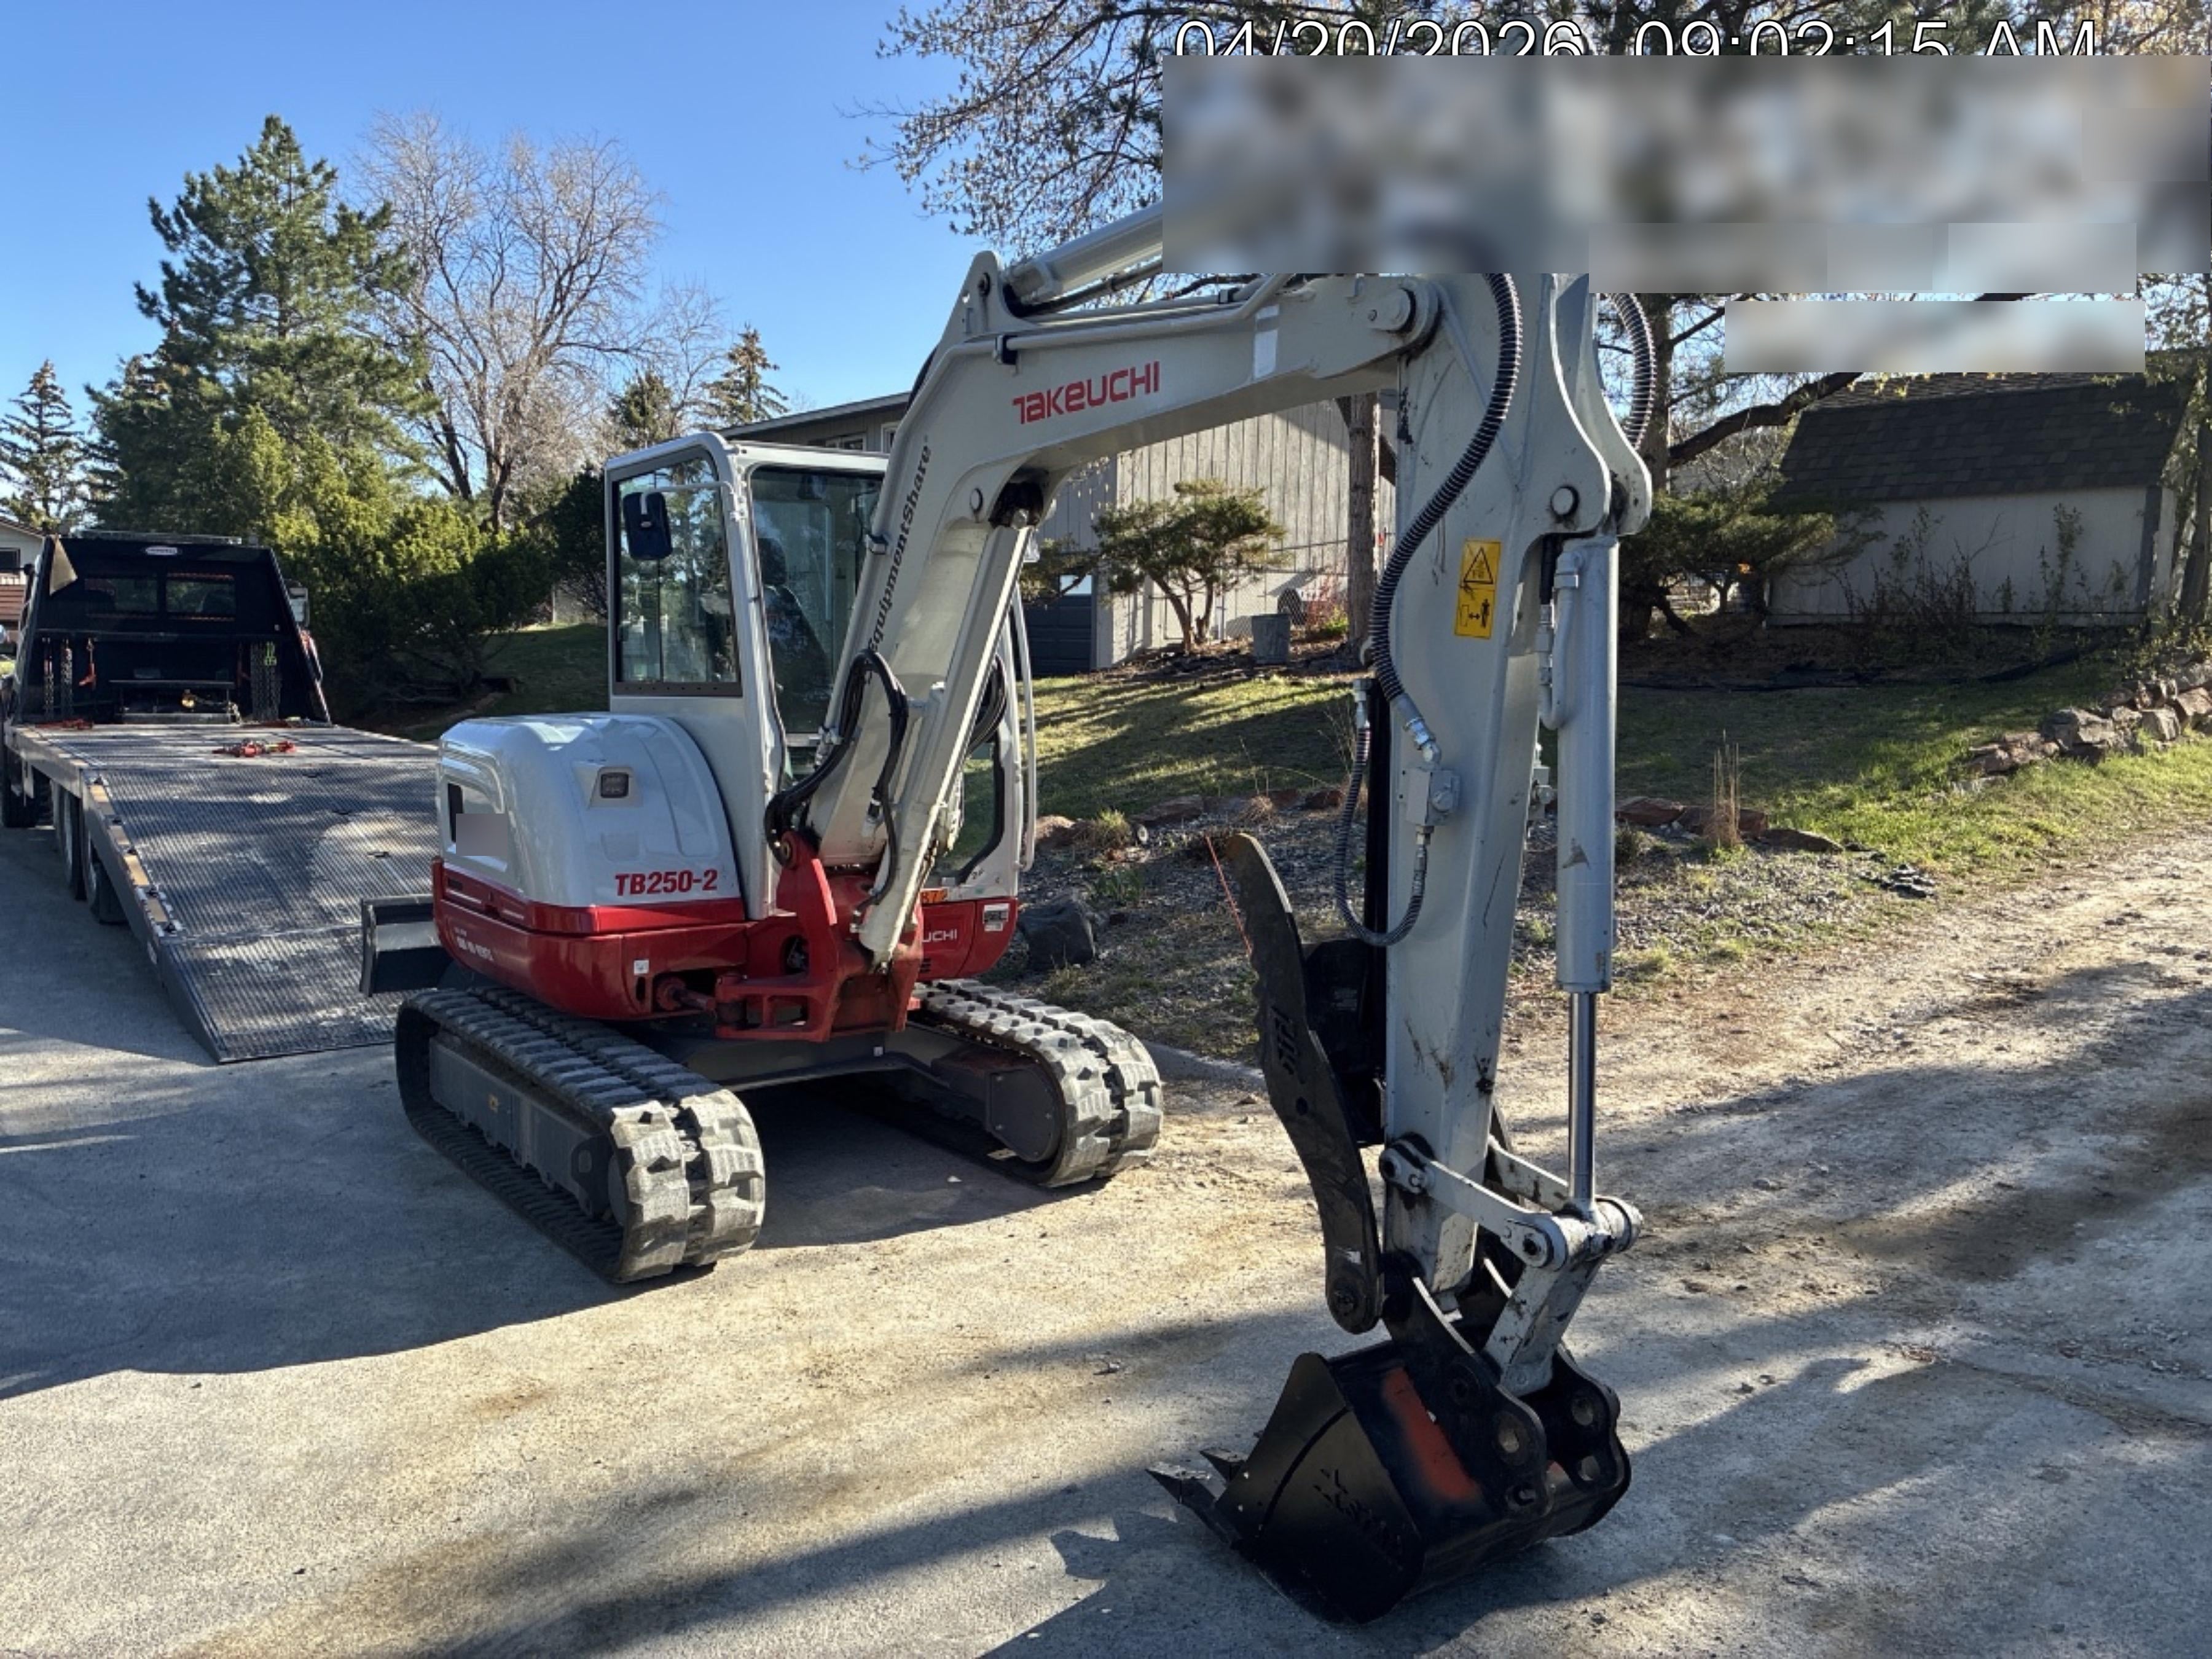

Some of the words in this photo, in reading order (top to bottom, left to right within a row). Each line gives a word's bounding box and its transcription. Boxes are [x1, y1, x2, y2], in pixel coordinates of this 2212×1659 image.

[1013, 361, 1160, 425] TAKEUCHI
[868, 445, 931, 652] EquipmentShare
[615, 869, 718, 896] TB250-2
